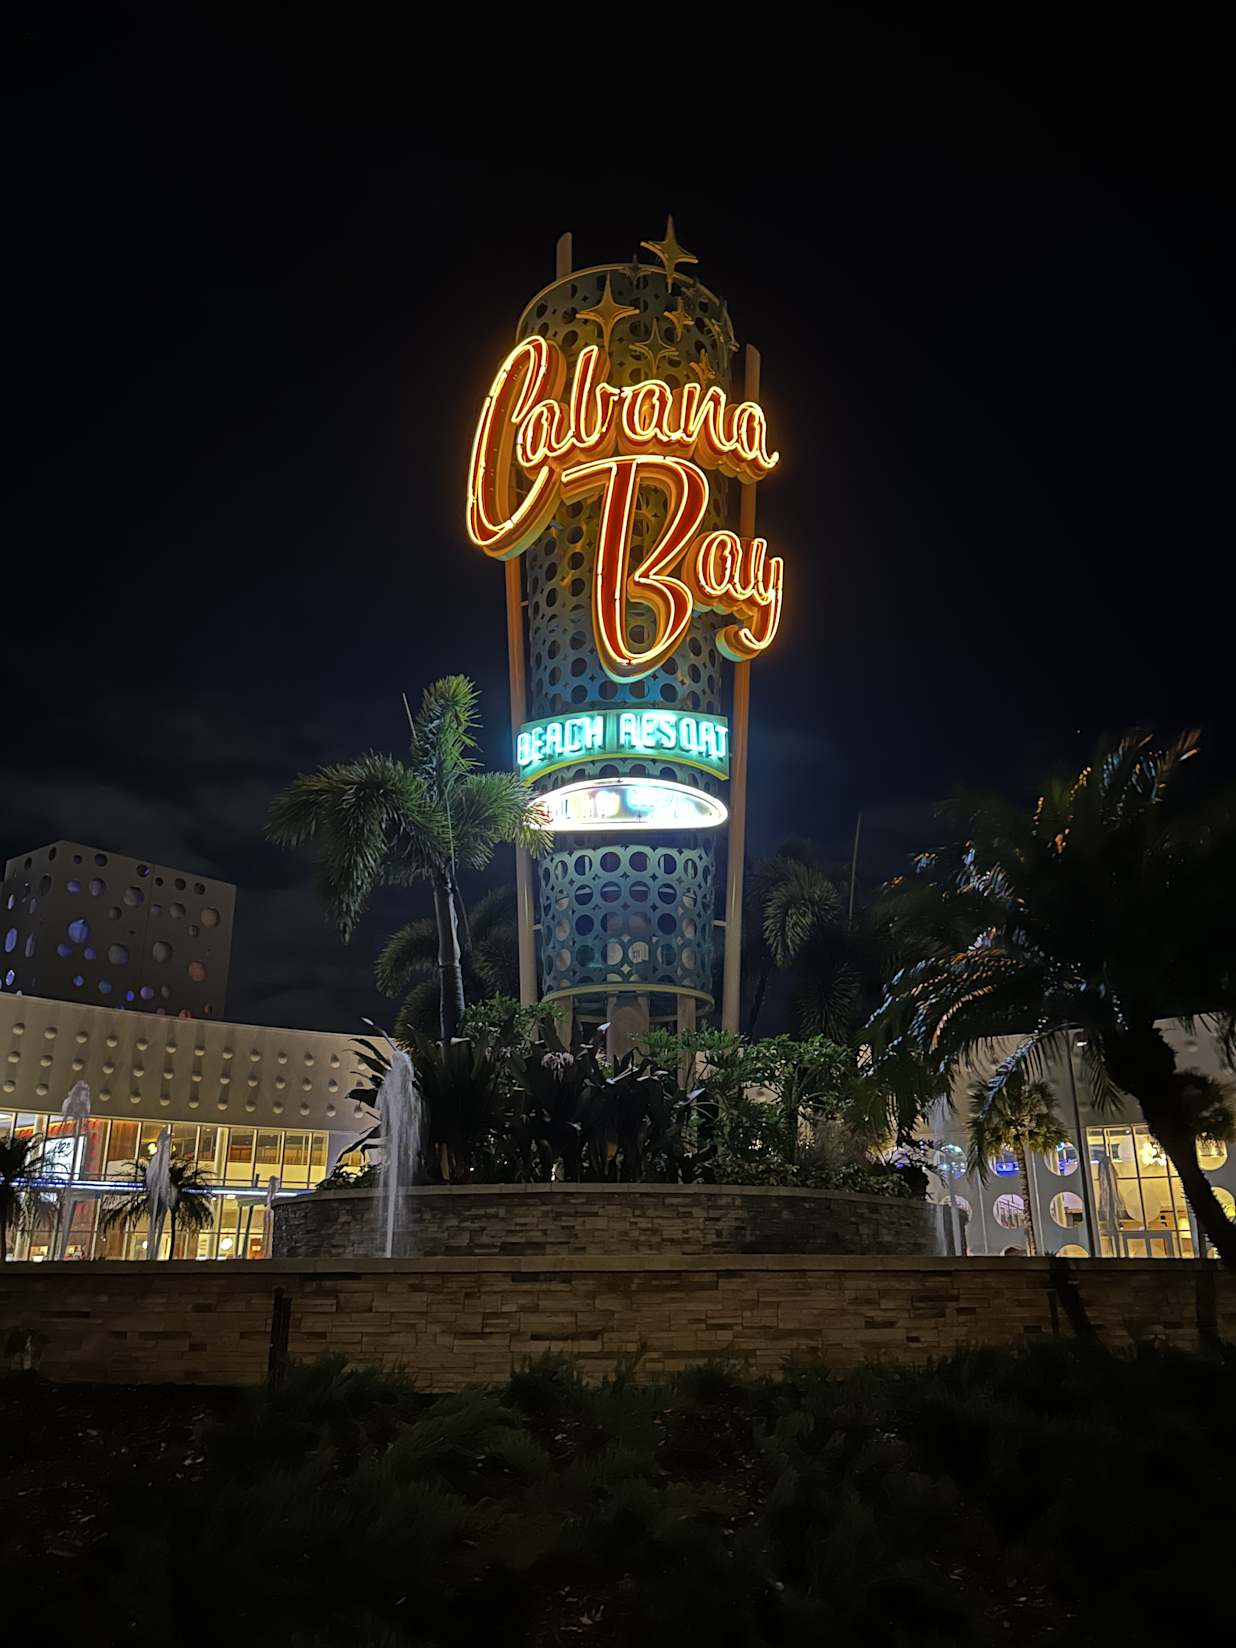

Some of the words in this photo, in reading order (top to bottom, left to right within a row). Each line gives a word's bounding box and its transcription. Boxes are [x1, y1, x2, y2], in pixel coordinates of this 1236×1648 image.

[466, 335, 780, 548] Cabana
[560, 454, 784, 667] Bay
[516, 714, 605, 767] BEACH
[618, 712, 729, 759] RESORT
